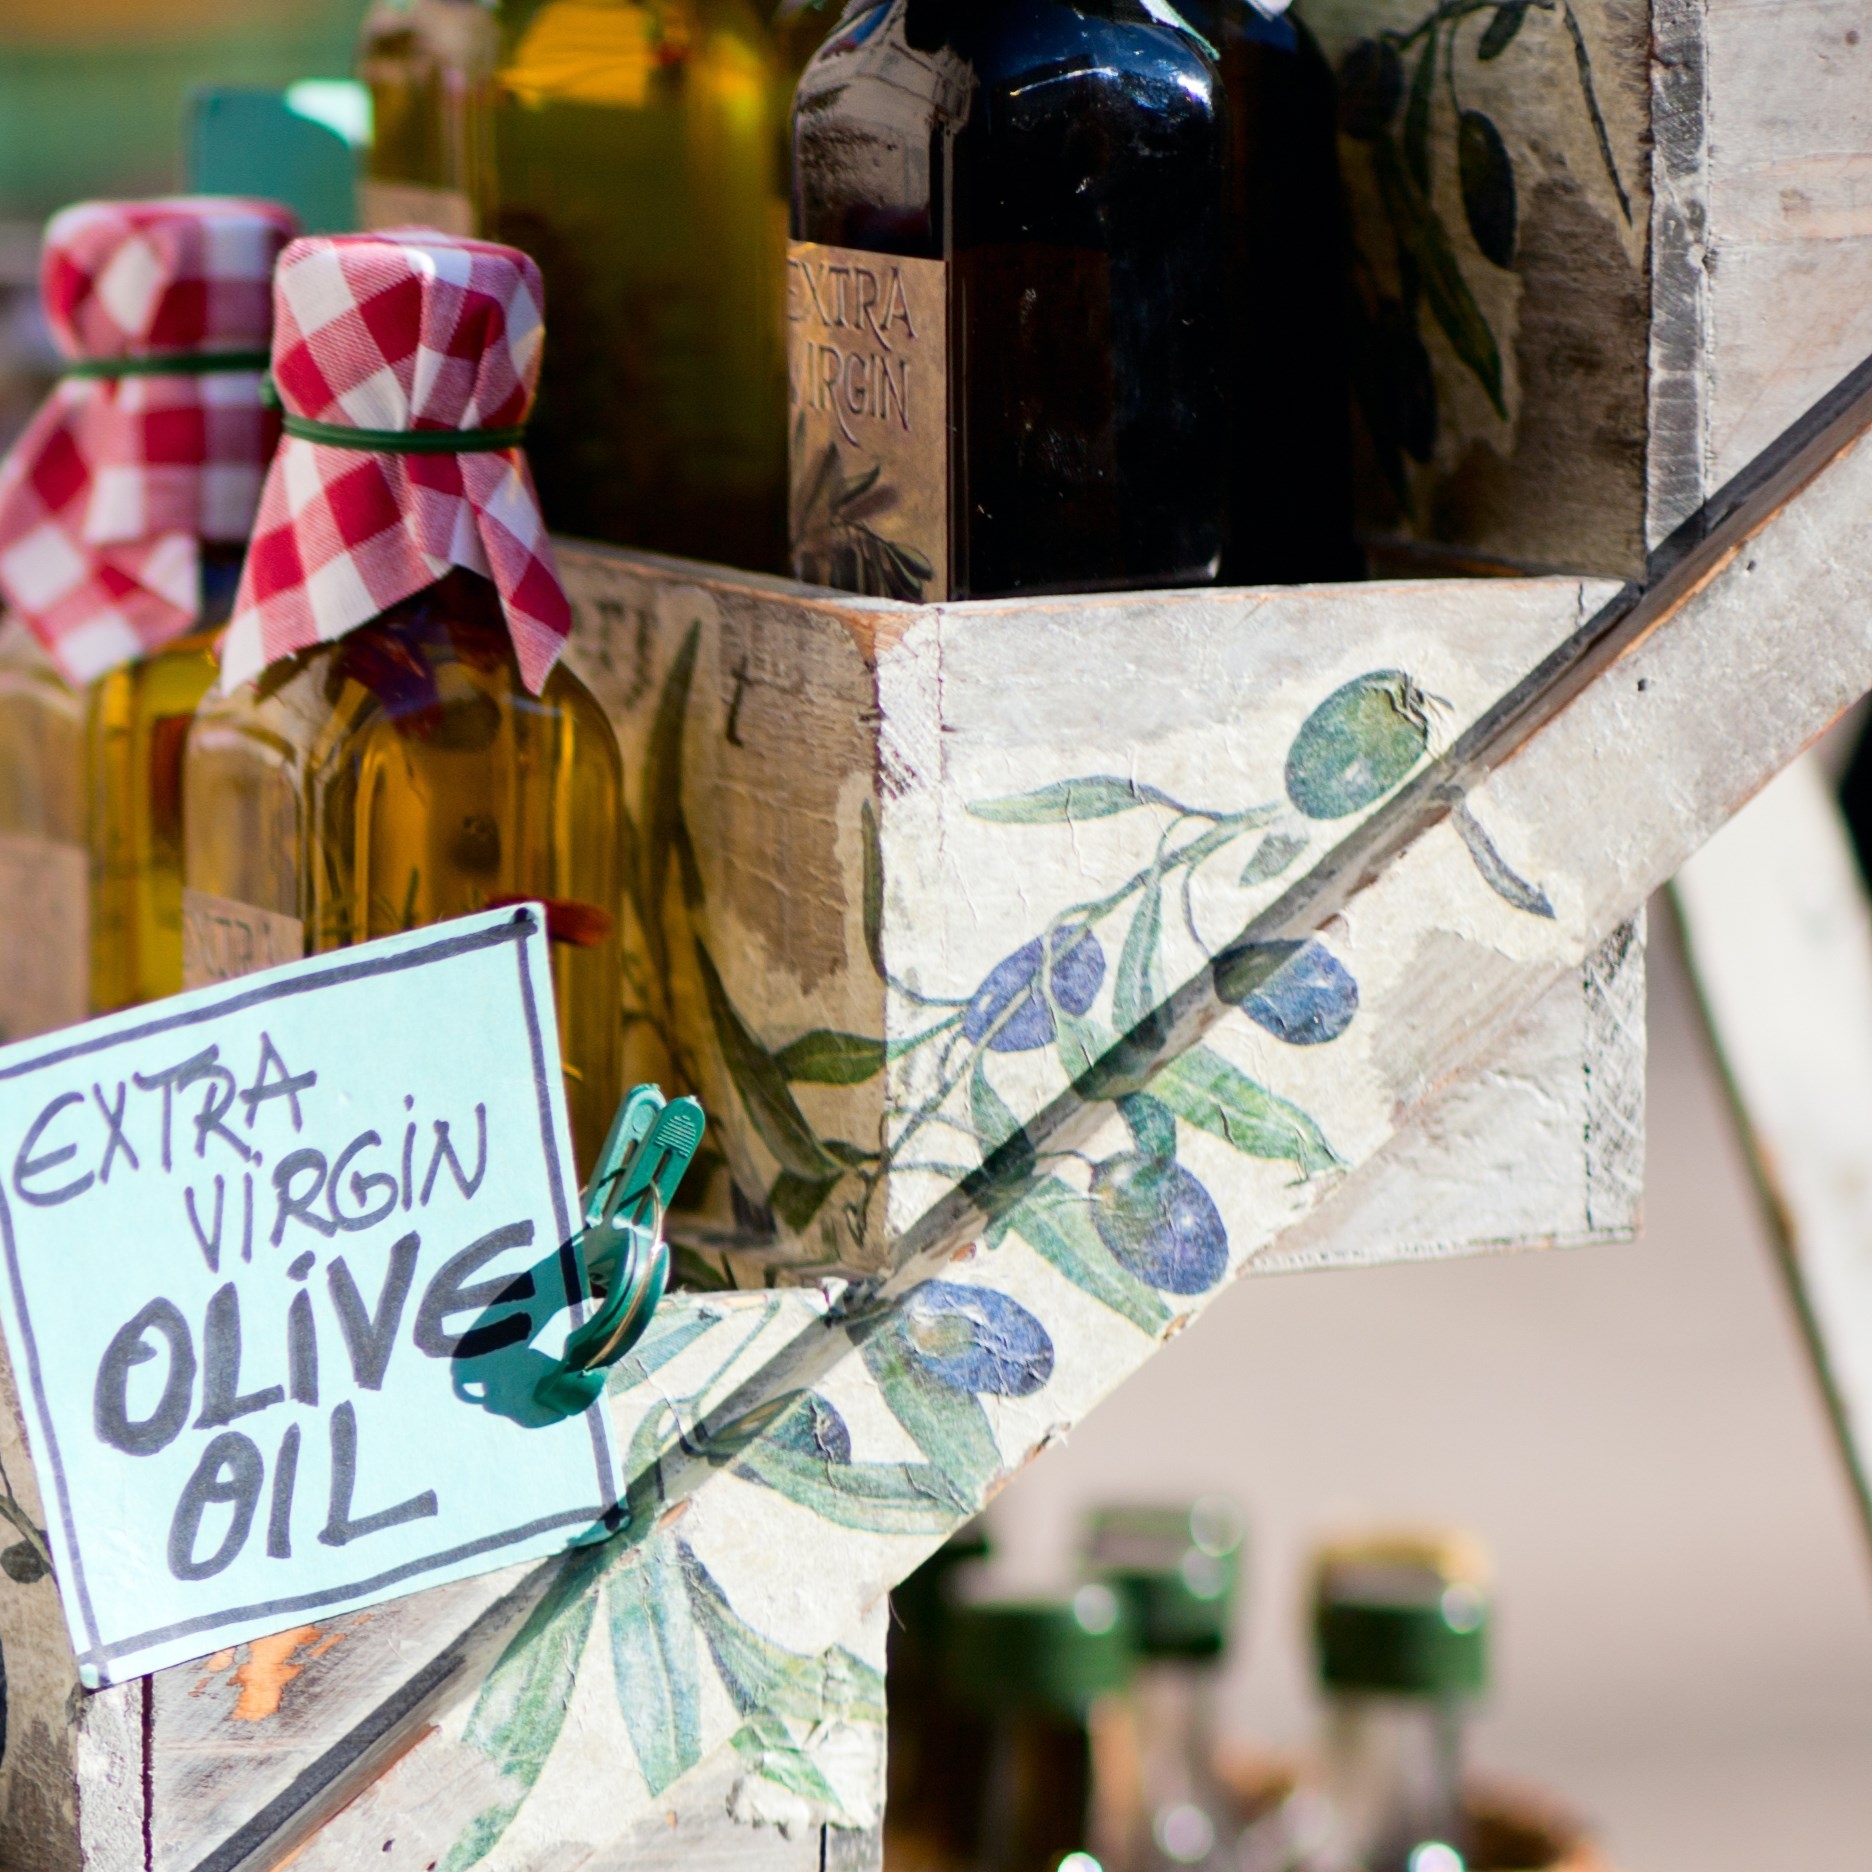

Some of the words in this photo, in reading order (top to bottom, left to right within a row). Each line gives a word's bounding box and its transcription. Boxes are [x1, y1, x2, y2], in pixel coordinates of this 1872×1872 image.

[789, 340, 912, 448] IRGIN
[11, 1031, 318, 1207] EXTRA
[166, 1400, 440, 1582] OIL
